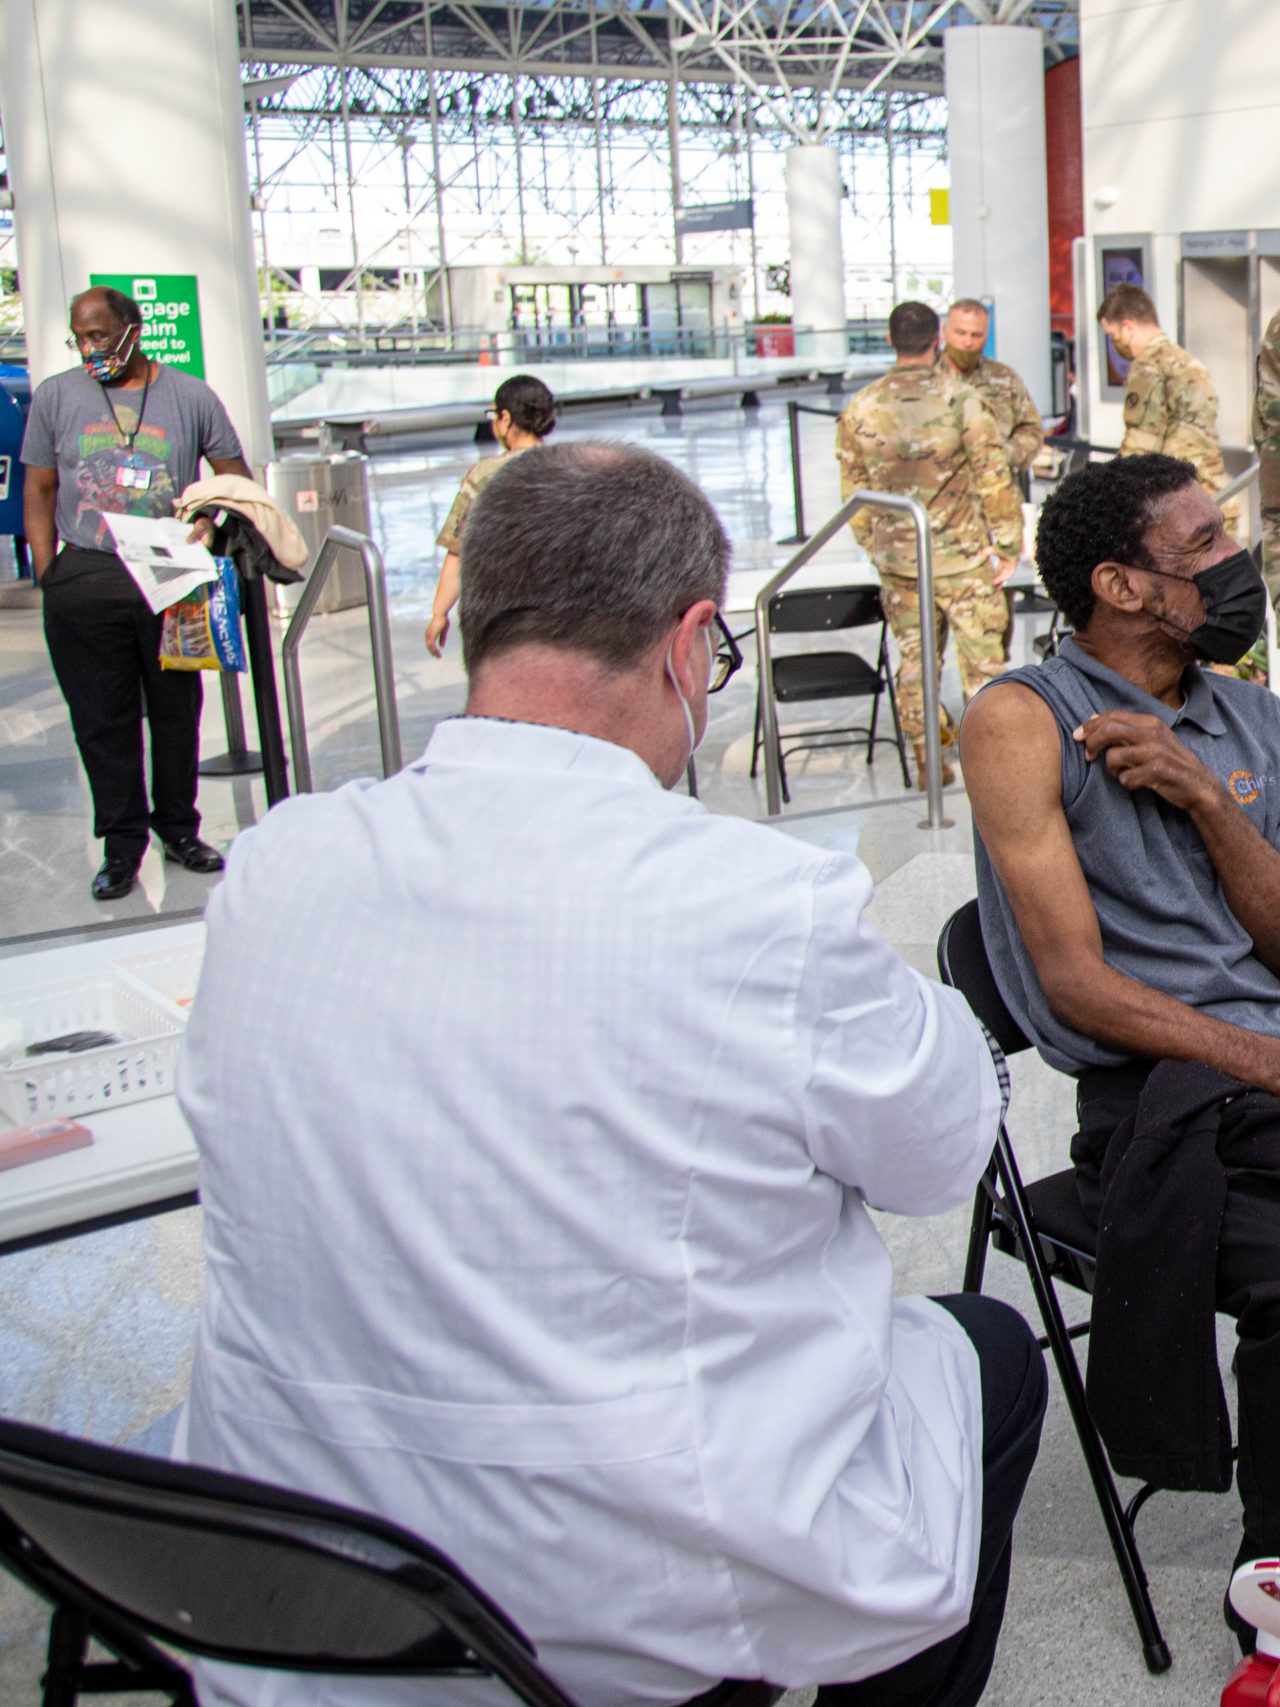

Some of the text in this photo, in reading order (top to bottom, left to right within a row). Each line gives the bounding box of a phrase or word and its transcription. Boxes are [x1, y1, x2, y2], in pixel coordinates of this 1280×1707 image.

[140, 302, 190, 320] gage
[142, 319, 177, 336] aim
[170, 339, 186, 350] to
